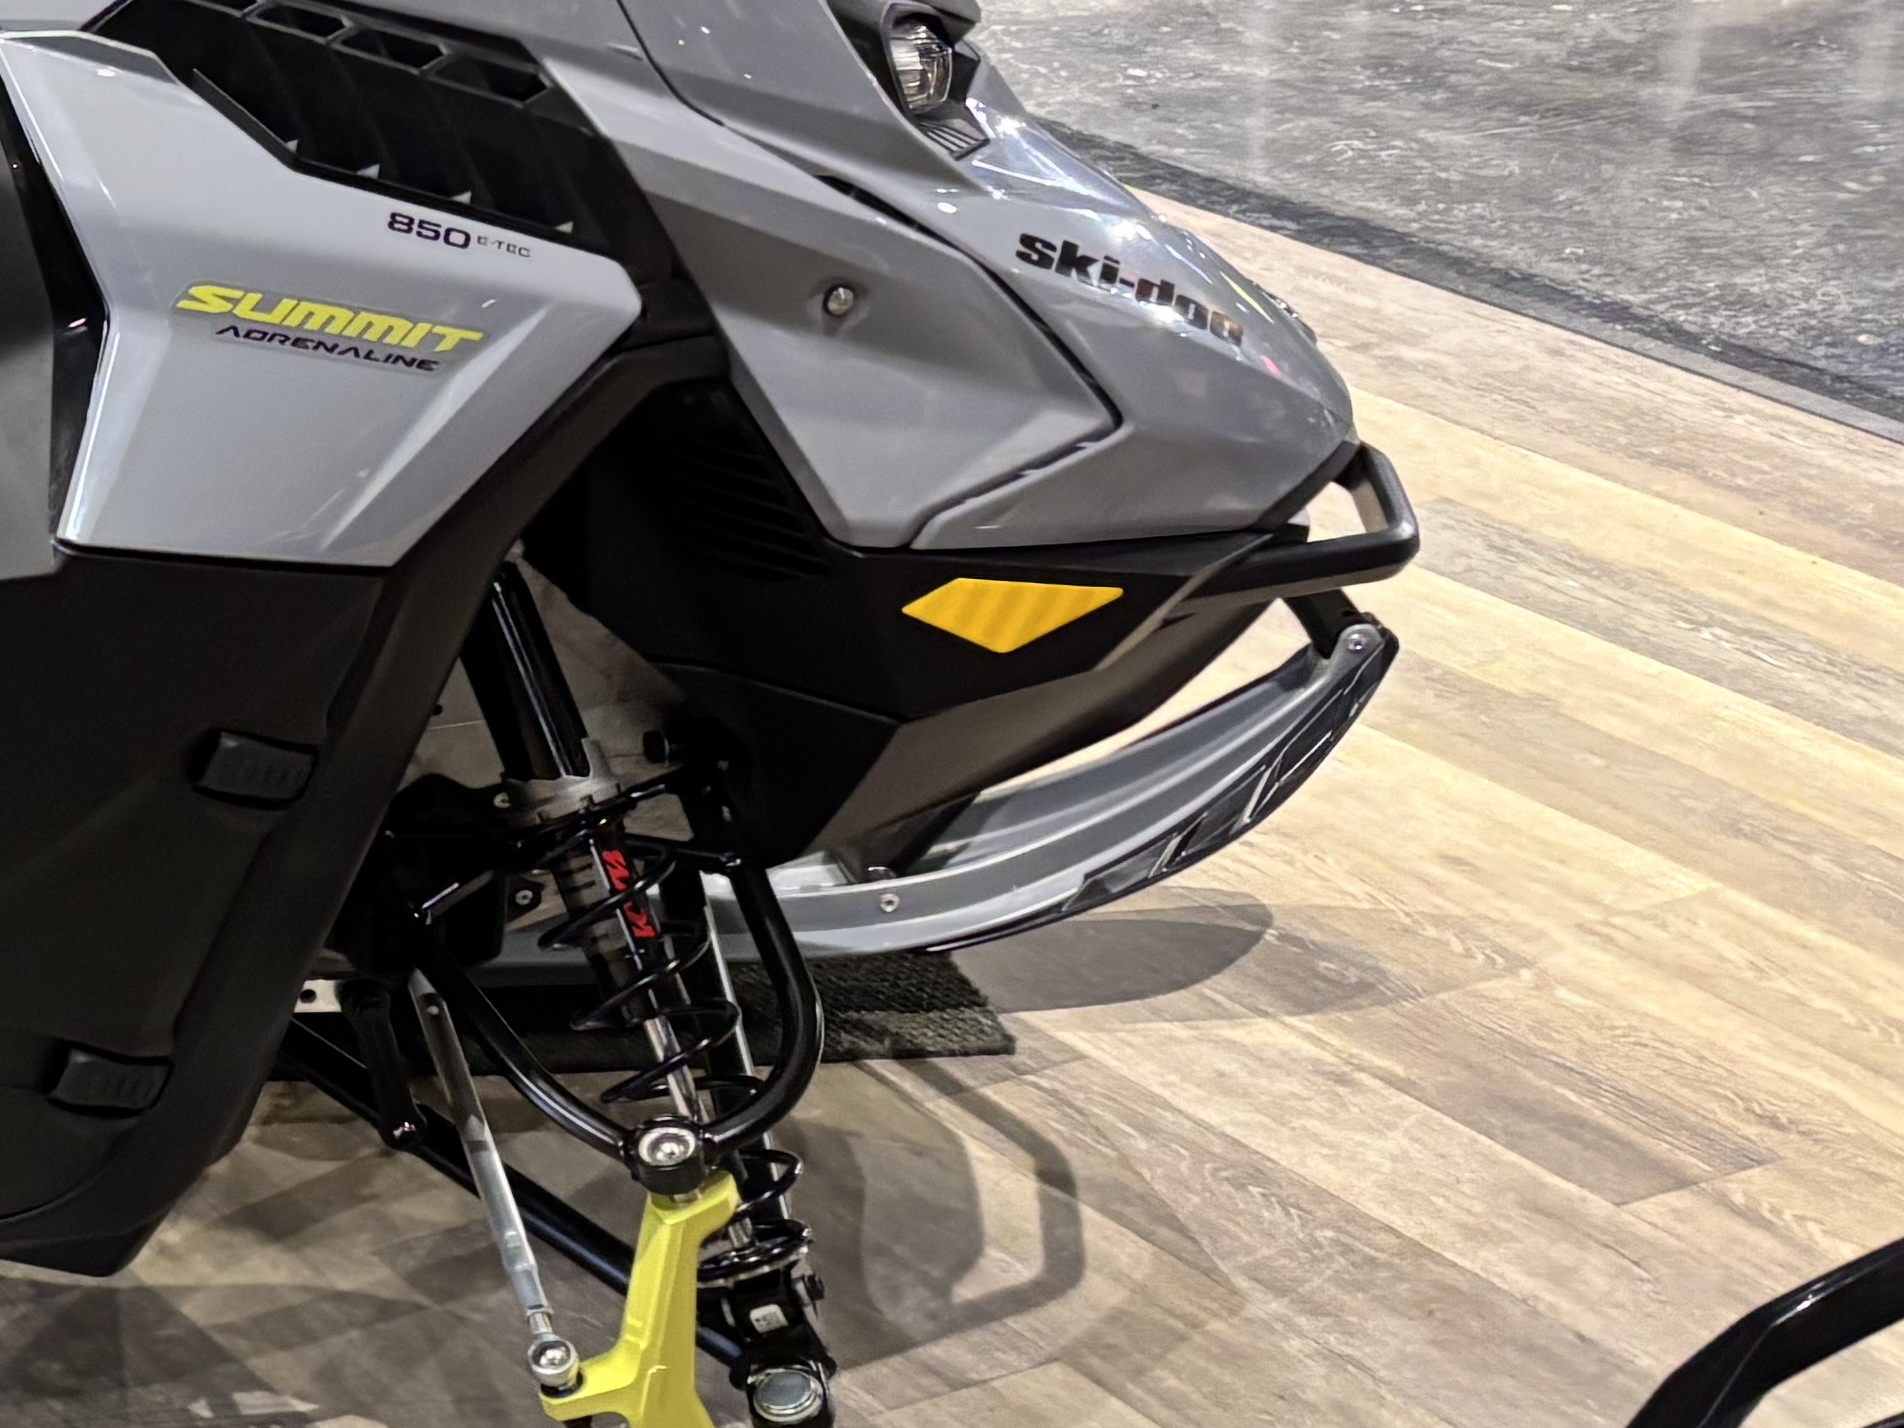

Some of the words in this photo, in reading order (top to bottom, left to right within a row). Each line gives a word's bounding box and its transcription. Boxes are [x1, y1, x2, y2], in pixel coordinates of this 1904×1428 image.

[386, 211, 471, 250] 850
[476, 234, 532, 259] E-TEC
[175, 283, 484, 354] SUMMIT
[1014, 231, 1245, 348] ski-doo
[213, 324, 441, 373] ADRENALINE
